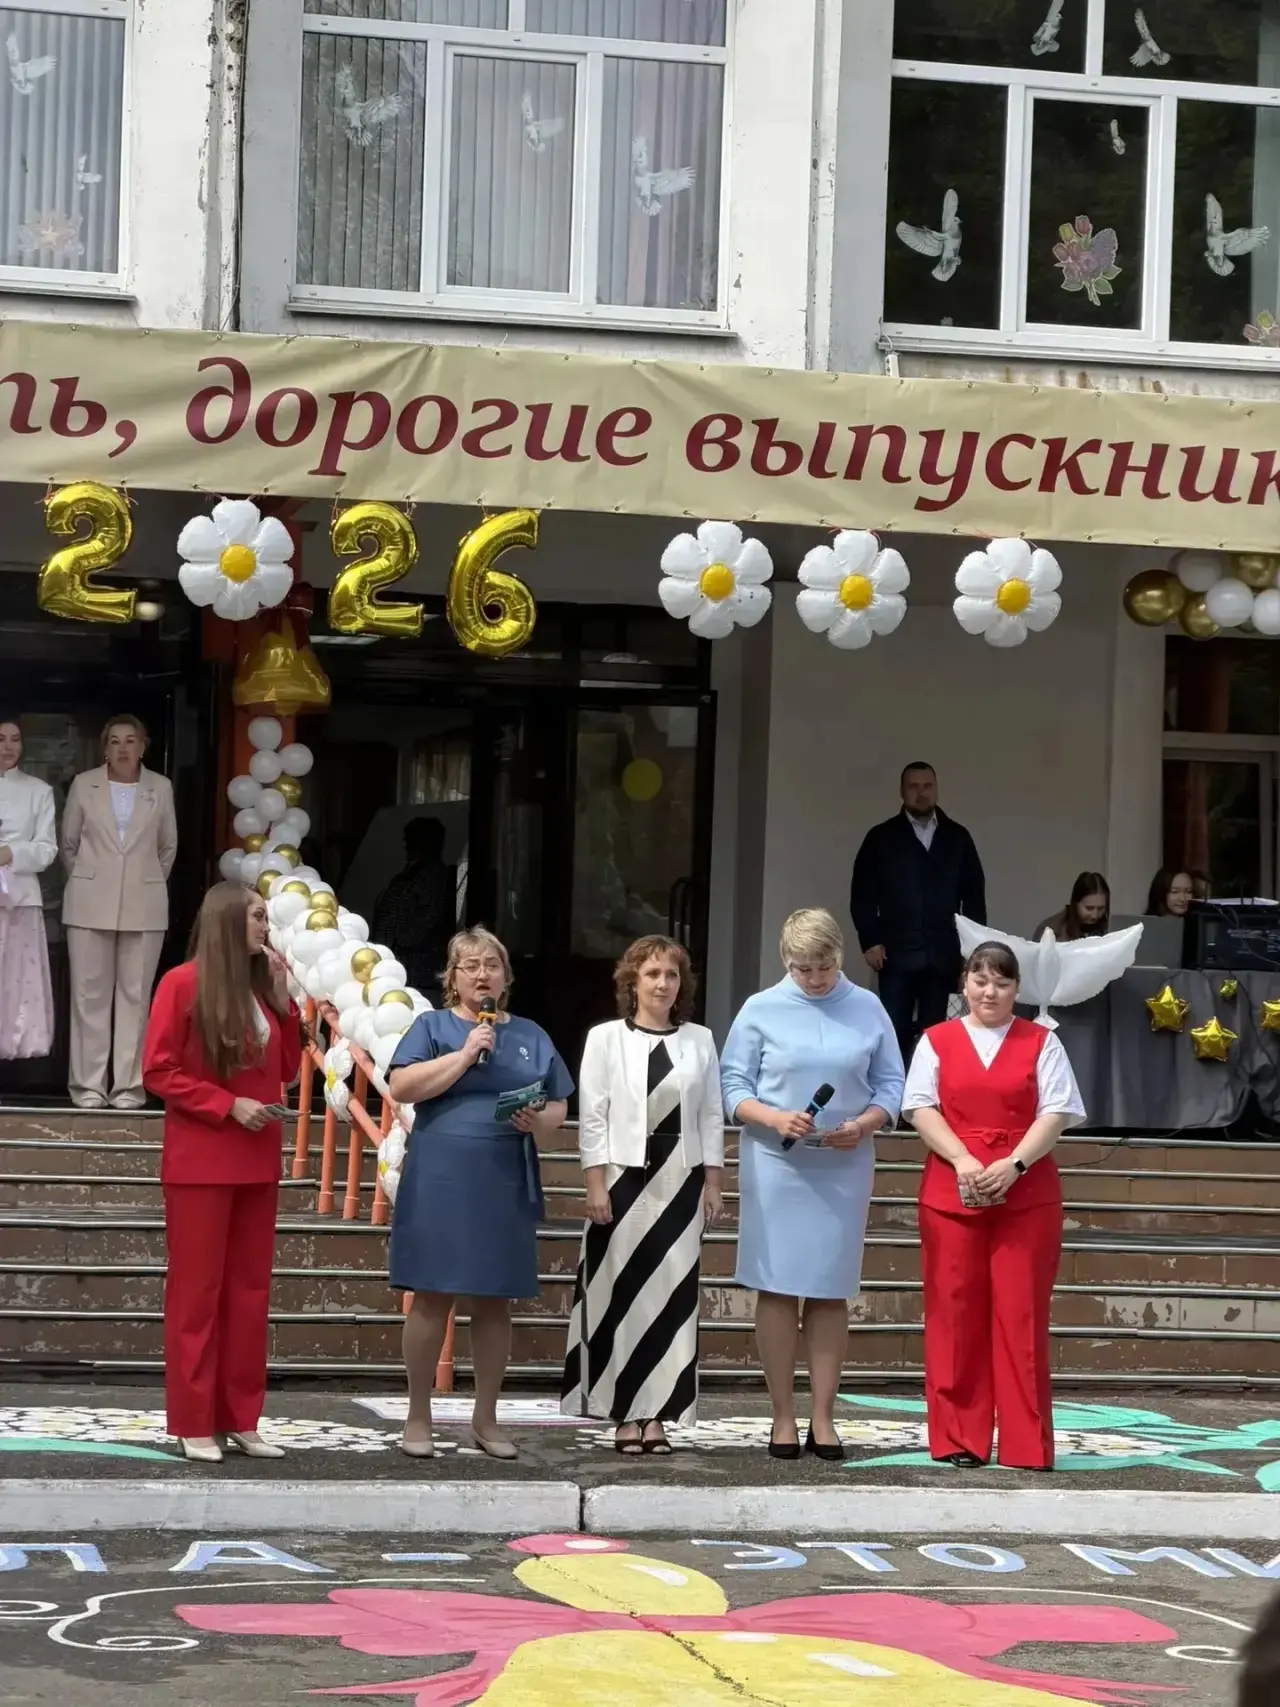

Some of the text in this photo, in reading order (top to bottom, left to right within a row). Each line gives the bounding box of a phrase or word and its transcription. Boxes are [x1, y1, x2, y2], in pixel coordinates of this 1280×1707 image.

[186, 356, 652, 477] дорогие
[685, 412, 1280, 513] выпускник
[690, 1539, 1028, 1573] ЭТО
